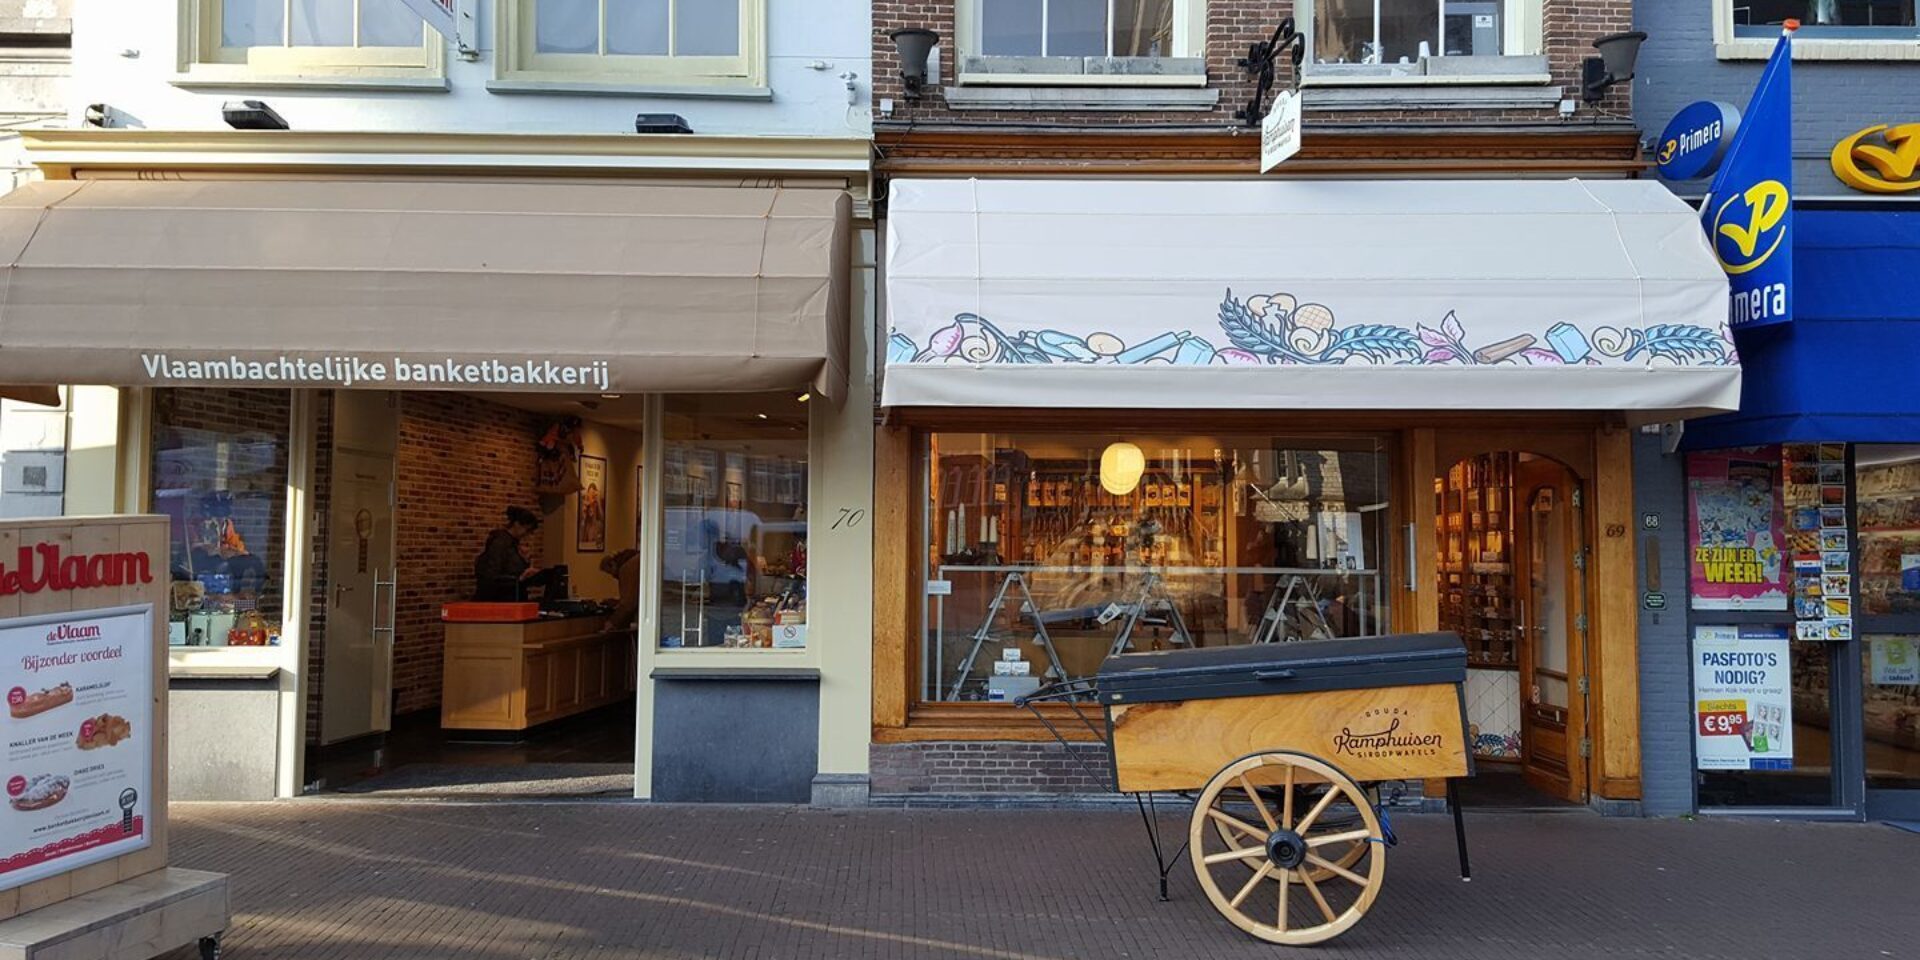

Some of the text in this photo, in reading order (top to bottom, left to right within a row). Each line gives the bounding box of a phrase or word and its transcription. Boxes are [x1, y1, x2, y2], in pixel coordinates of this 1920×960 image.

[1679, 118, 1722, 157] Primera
[1729, 282, 1785, 325] imera
[142, 353, 610, 391] Vlaambachtelijke banketbakkerij
[829, 506, 866, 531] 70
[1645, 515, 1658, 527] 68
[1604, 523, 1626, 538] 69
[1696, 547, 1755, 563] ZE ZIJN ER
[1704, 562, 1763, 584] WEER!
[21, 645, 122, 673] Bijzonder voordeel
[1702, 652, 1777, 666] PASFOTO'S
[1715, 669, 1766, 685] NODIG?
[1365, 707, 1408, 718] GOUDA
[1707, 702, 1737, 711] Slechts
[1334, 718, 1443, 756] Kamphuisen
[1356, 749, 1436, 759] SIROOPWAFELS
